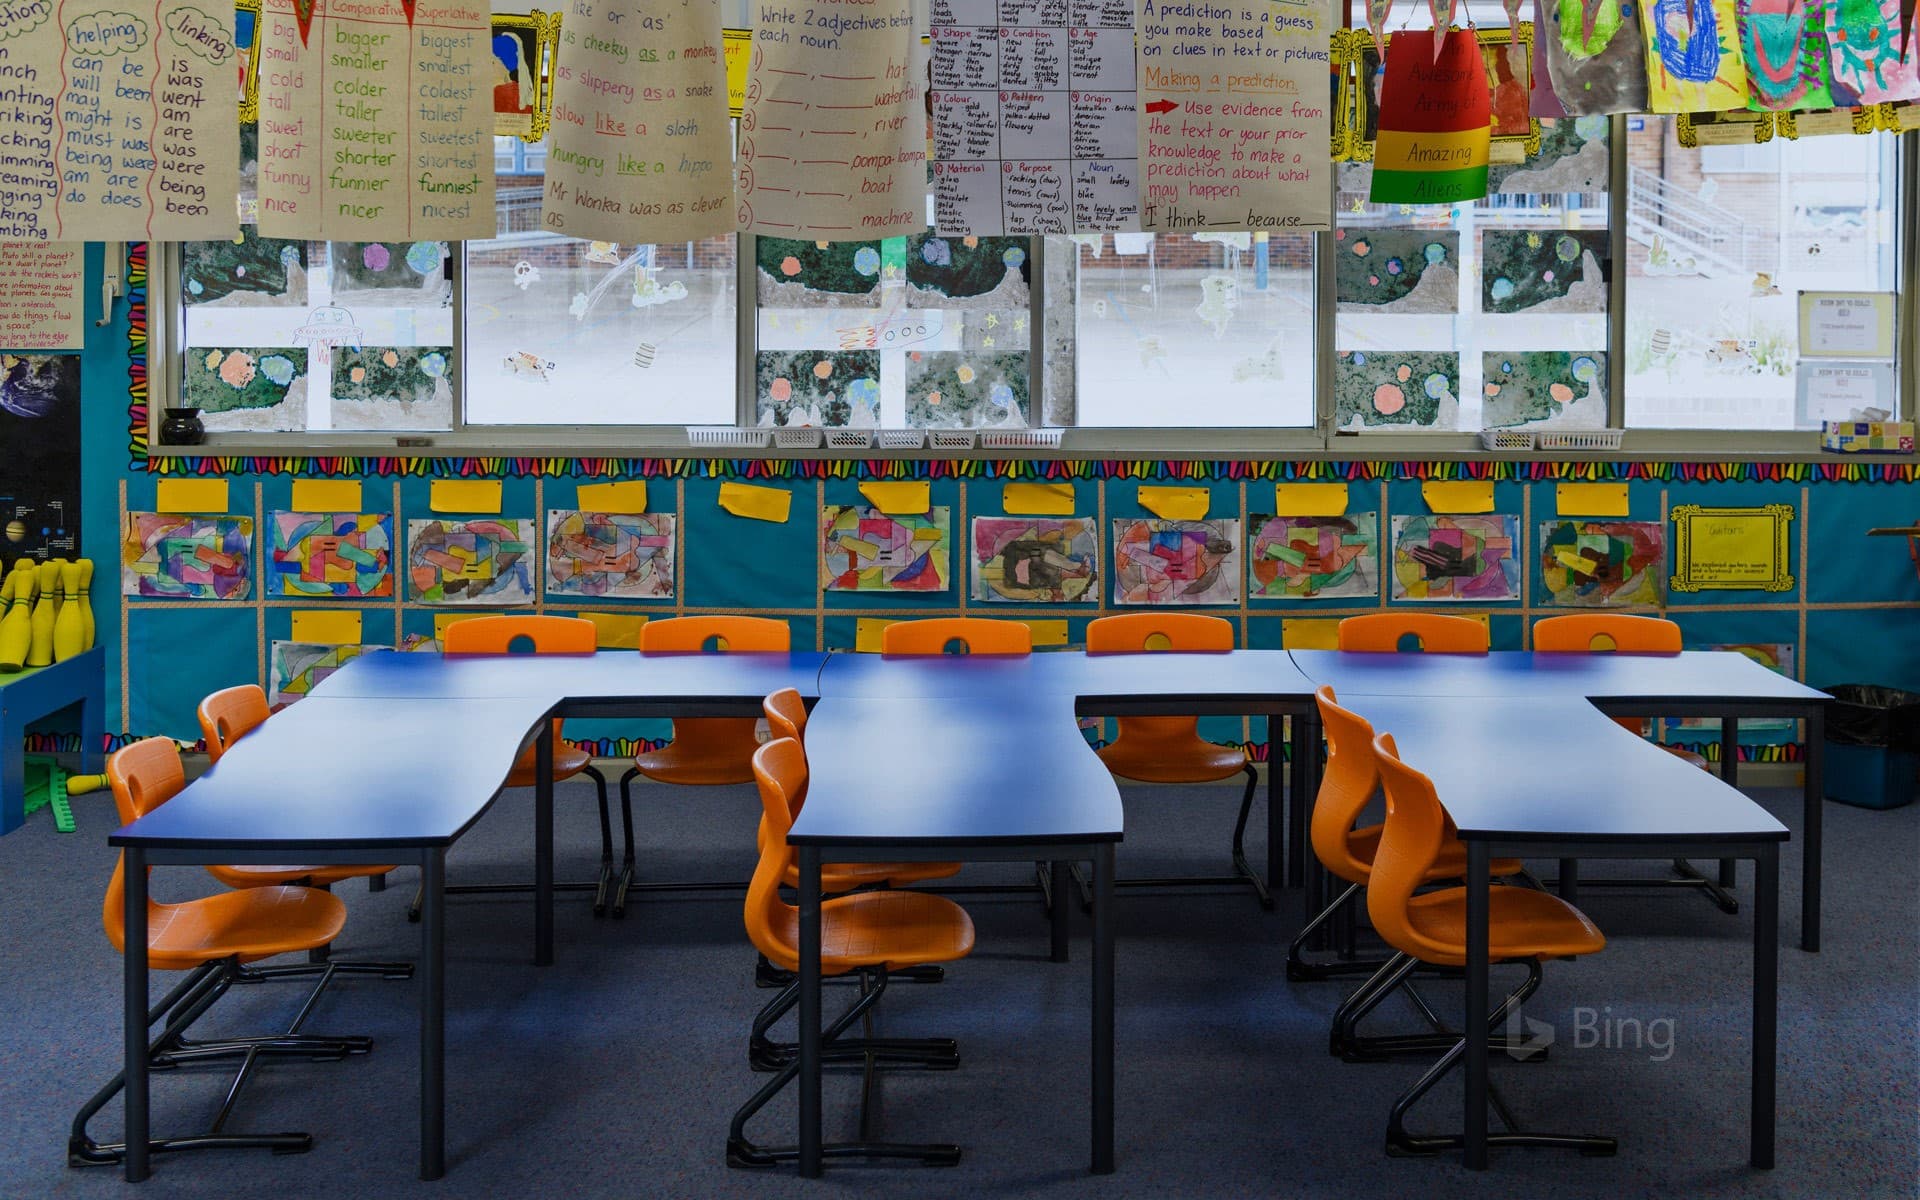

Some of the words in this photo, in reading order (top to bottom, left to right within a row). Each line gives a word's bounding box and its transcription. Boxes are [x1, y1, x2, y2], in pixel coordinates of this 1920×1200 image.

[332, 0, 405, 16] Comparative
[608, 11, 625, 24] or
[1144, 4, 1154, 17] A
[1161, 4, 1231, 21] prediction
[1241, 9, 1252, 20] is
[1276, 15, 1313, 31] guess
[762, 6, 795, 25] Write
[805, 10, 813, 25] 2
[818, 15, 886, 37] adjectives
[890, 11, 913, 27] before
[1145, 26, 1168, 39] you
[1176, 23, 1211, 37] make
[1222, 24, 1263, 38] based
[76, 24, 137, 45] helping
[177, 15, 226, 59] linking
[273, 21, 294, 44] big
[336, 23, 390, 54] bigger
[421, 30, 474, 57] biggest
[760, 28, 789, 43] each
[800, 36, 841, 49] noun.
[944, 30, 971, 41] Shape
[1013, 29, 1050, 38] Condition
[1084, 30, 1098, 40] Age
[564, 31, 575, 44] as
[584, 37, 628, 64] cheeky
[684, 41, 717, 64] monkey
[1144, 45, 1160, 56] on
[1173, 43, 1206, 55] clues
[1213, 44, 1225, 56] in
[1234, 43, 1261, 56] text
[1266, 48, 1279, 57] or
[73, 56, 102, 72] can
[123, 57, 143, 77] be
[172, 58, 188, 72] is
[266, 47, 298, 63] small
[331, 53, 388, 71] smaller
[419, 60, 473, 74] smallest
[886, 58, 907, 79] hat
[169, 75, 203, 88] was
[270, 73, 303, 88] cold
[334, 79, 387, 96] colder
[419, 80, 476, 99] coldest
[558, 66, 571, 80] as
[580, 72, 634, 104] slippery
[685, 86, 712, 96] snake
[1145, 67, 1200, 90] Making
[73, 76, 100, 91] will
[116, 81, 150, 101] been
[875, 82, 919, 105] waterfall
[1011, 92, 1044, 102] Pattern
[67, 92, 99, 111] may
[163, 92, 205, 108] went
[267, 93, 290, 111] tall
[336, 100, 382, 121] taller
[419, 104, 467, 122] tallest
[944, 94, 972, 103] Colour
[1084, 94, 1111, 103] Origin
[163, 109, 190, 123] am
[1186, 103, 1212, 115] Use
[1223, 102, 1282, 116] evidence
[1292, 101, 1322, 118] from
[65, 110, 112, 130] might
[126, 114, 141, 130] is
[556, 106, 584, 125] slow
[596, 112, 626, 133] like
[666, 120, 698, 136] sloth
[875, 116, 907, 131] river
[966, 121, 997, 129] colourful
[1005, 123, 1033, 134] flowery
[67, 132, 113, 148] must
[123, 138, 149, 151] was
[164, 128, 192, 140] are
[265, 119, 303, 136] sweet
[333, 126, 397, 145] sweeter
[419, 128, 483, 145] sweetest
[1149, 119, 1171, 135] the
[1181, 120, 1213, 137] text
[1219, 127, 1234, 137] or
[1240, 128, 1270, 146] your
[1276, 128, 1307, 145] prior
[164, 145, 196, 157] was
[265, 141, 307, 159] short
[336, 150, 396, 166] shorter
[419, 151, 479, 169] shortest
[553, 142, 604, 177] hungry
[617, 154, 646, 173] like
[678, 154, 712, 178] hippo
[1150, 139, 1221, 166] knowledge
[1231, 145, 1244, 161] to
[1251, 149, 1285, 163] make
[1407, 143, 1472, 165] Amazing
[67, 150, 112, 173] being
[123, 158, 156, 170] were
[163, 161, 204, 175] were
[948, 163, 984, 173] Material
[1019, 163, 1052, 175] Purpose
[1090, 162, 1113, 172] Noun
[64, 172, 89, 183] am
[107, 176, 138, 189] are
[264, 164, 311, 193] funny
[329, 167, 390, 191] funnier
[418, 172, 482, 194] funniest
[1110, 176, 1130, 186] lovely
[1148, 162, 1224, 180] prediction
[1232, 166, 1270, 179] about
[1279, 168, 1310, 181] what
[160, 176, 205, 201] being
[861, 175, 893, 193] boat
[1149, 184, 1178, 203] may
[1190, 182, 1240, 201] happen
[1415, 180, 1462, 197] Aliens
[66, 189, 85, 203] do
[102, 192, 141, 208] does
[551, 181, 568, 200] Mr
[575, 187, 620, 213] Wonka
[630, 202, 660, 214] was
[667, 201, 683, 213] as
[691, 197, 725, 212] clever
[1007, 201, 1042, 213] swimming
[166, 201, 208, 215] been
[265, 198, 296, 213] nice
[339, 203, 384, 218] nicer
[422, 201, 470, 218] nicest
[1076, 204, 1089, 212] The
[1094, 204, 1115, 214] lovely
[1147, 206, 1157, 227] I
[1166, 207, 1205, 226] think
[1247, 209, 1300, 226] because
[547, 212, 564, 228] as
[862, 209, 913, 227] machine
